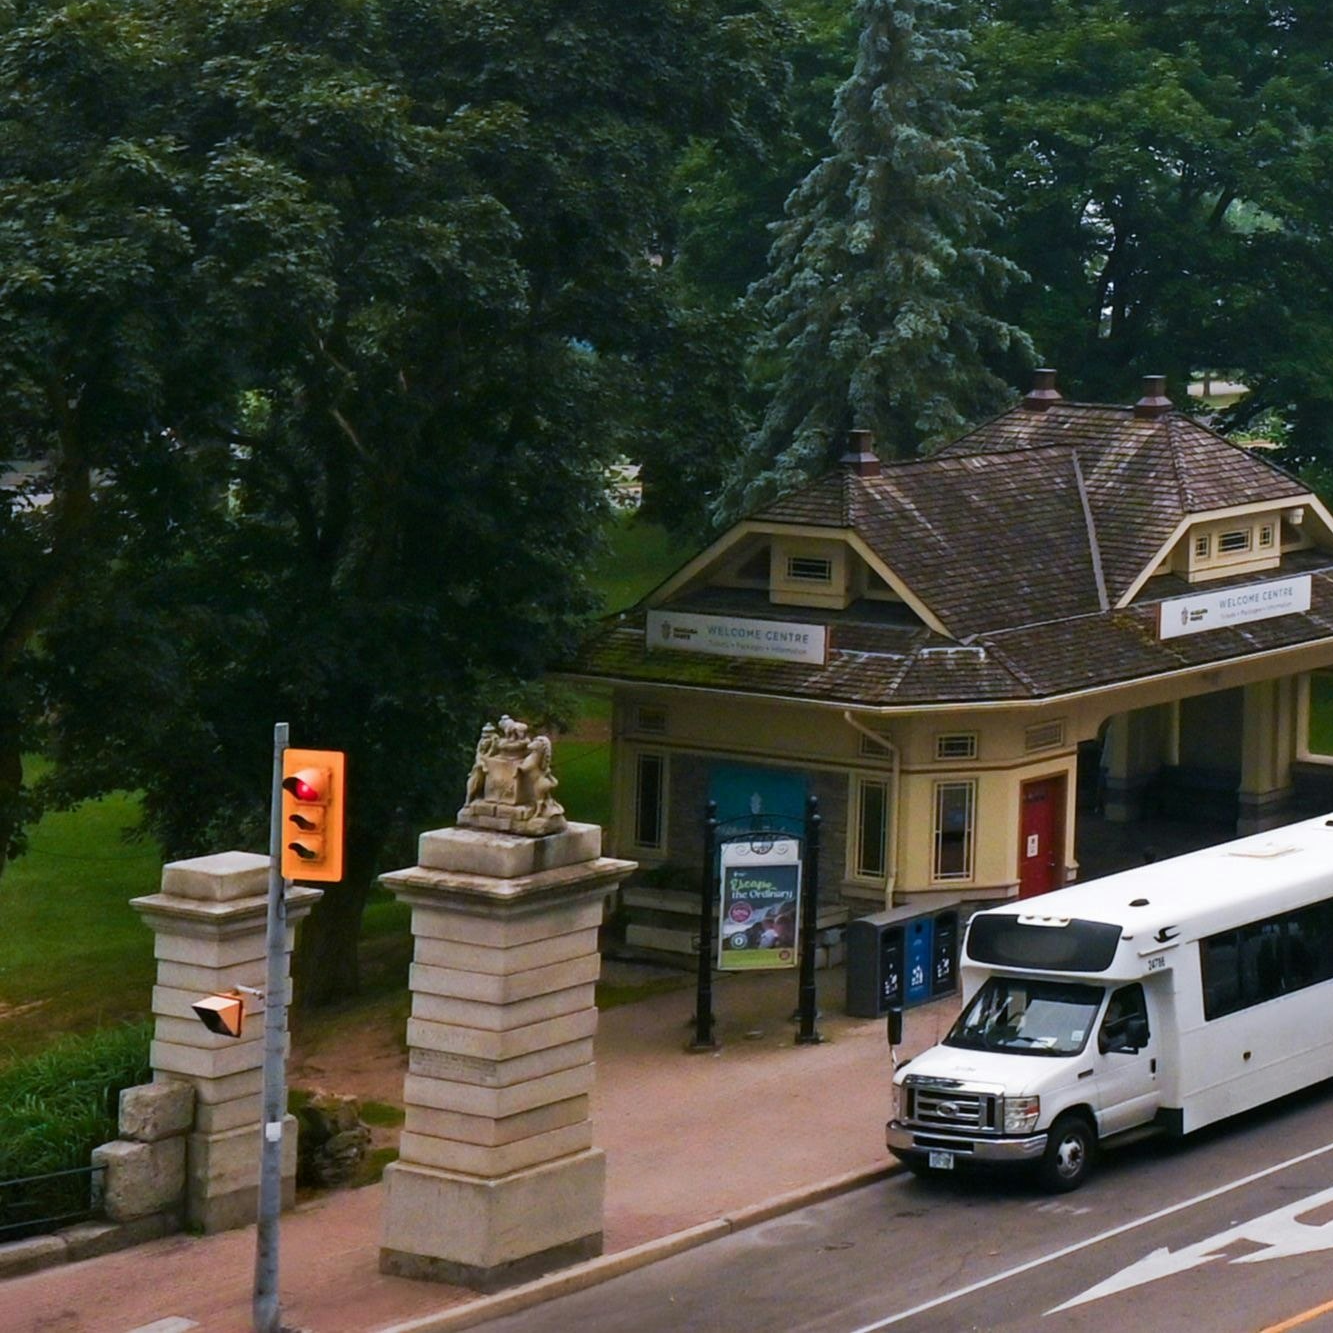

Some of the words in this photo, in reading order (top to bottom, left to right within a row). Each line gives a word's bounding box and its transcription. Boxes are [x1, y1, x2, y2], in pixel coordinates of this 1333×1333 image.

[1219, 590, 1260, 609] WELCOME
[1263, 586, 1294, 601] CENTRE
[707, 625, 762, 641] WELCOME
[765, 630, 809, 644] CENTRE
[749, 888, 793, 900] Ordinary
